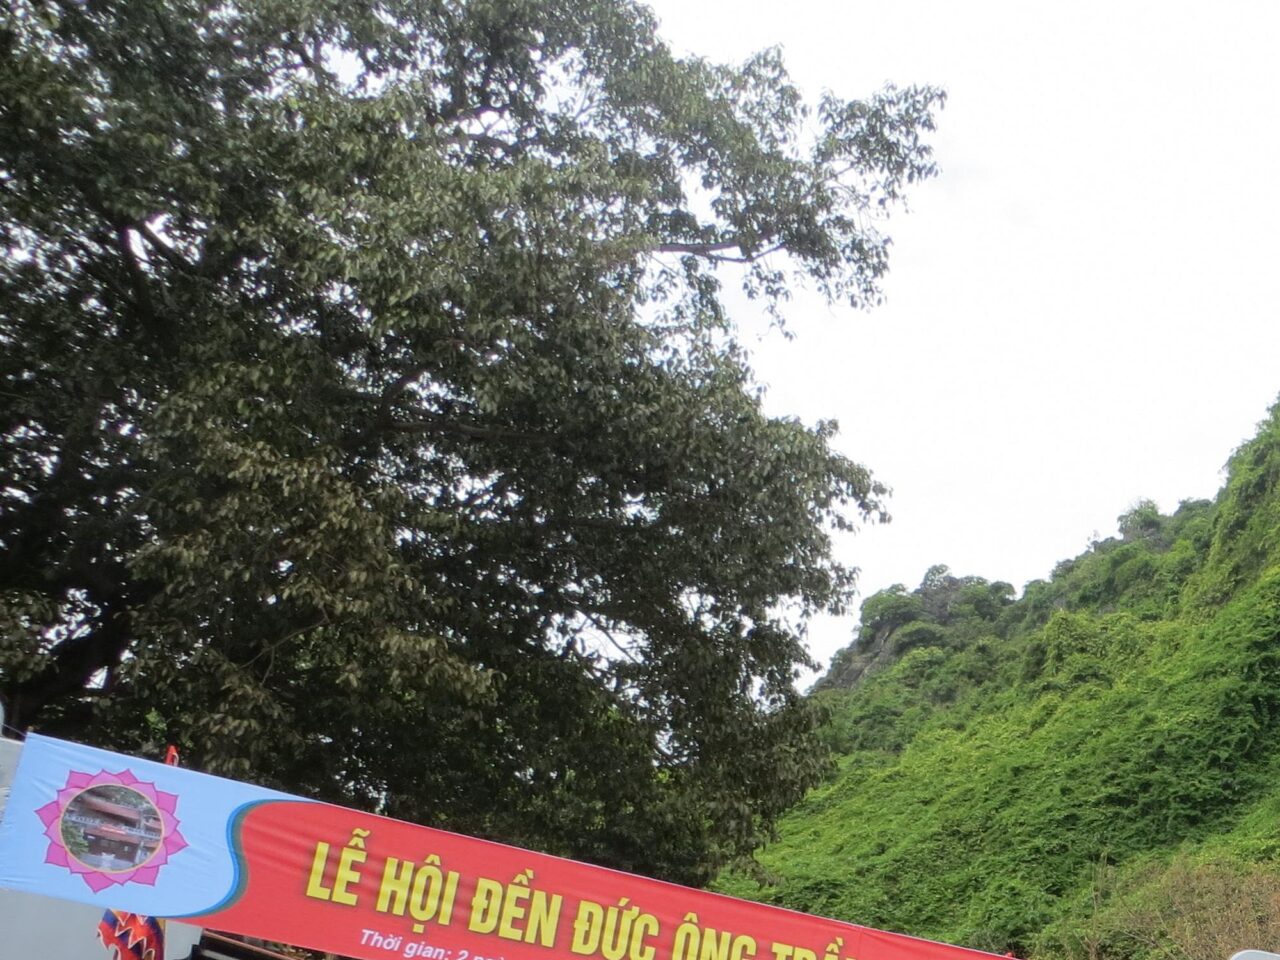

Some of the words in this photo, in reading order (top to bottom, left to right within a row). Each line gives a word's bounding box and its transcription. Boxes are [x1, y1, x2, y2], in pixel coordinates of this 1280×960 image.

[306, 827, 371, 906] LỄ
[376, 854, 460, 934] HỘI
[468, 868, 563, 948] ĐỀN
[360, 929, 403, 952] Thời
